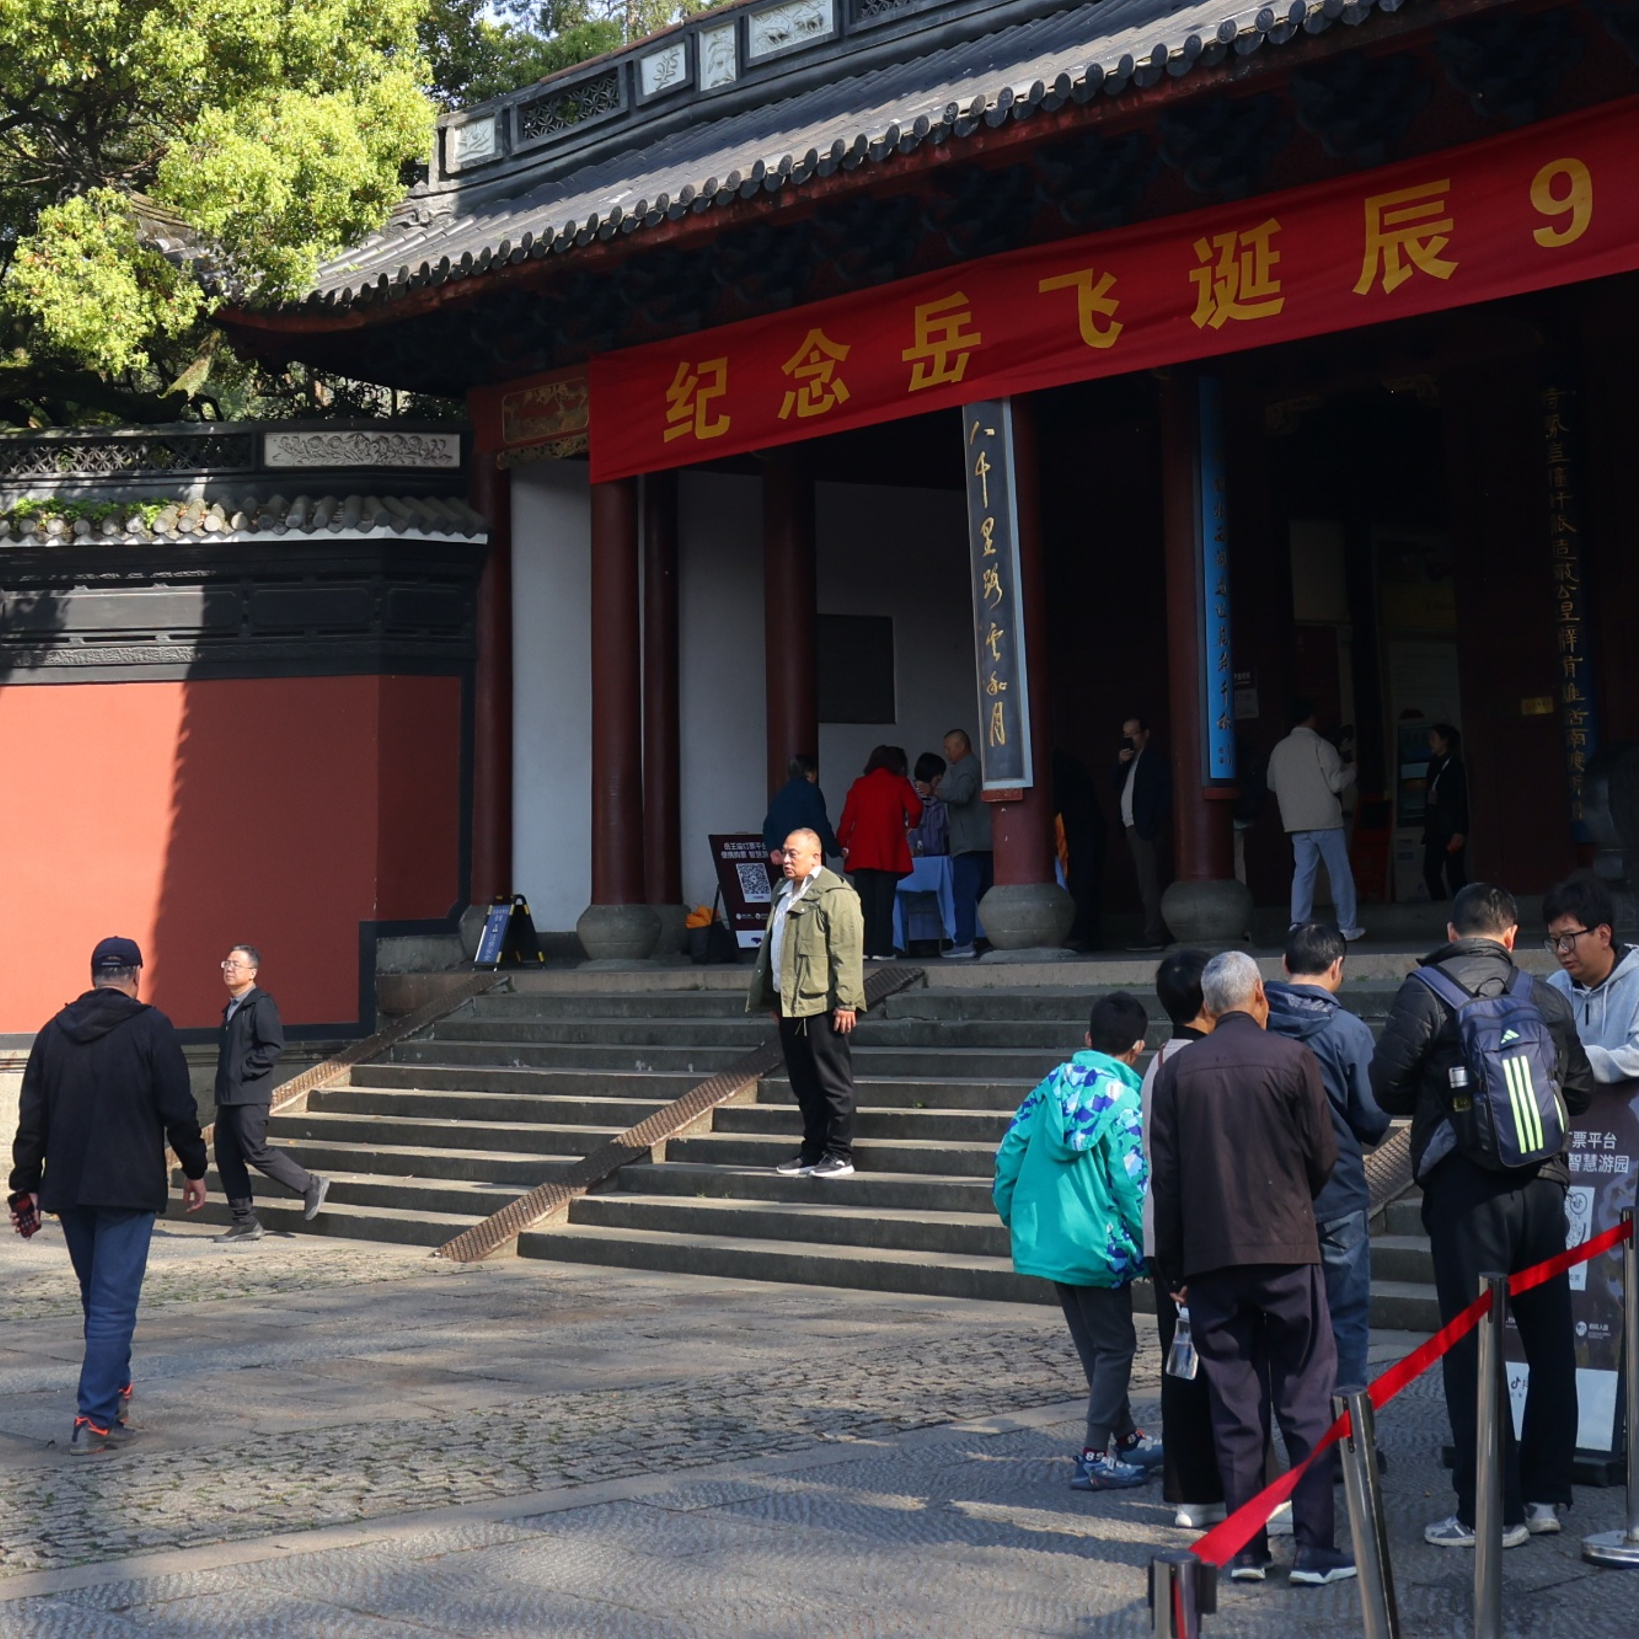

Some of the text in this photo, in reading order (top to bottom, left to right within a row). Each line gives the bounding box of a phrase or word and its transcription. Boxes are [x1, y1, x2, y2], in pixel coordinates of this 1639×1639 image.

[1569, 1130, 1617, 1150] 票平台
[1568, 1153, 1630, 1174] 智慧游园
